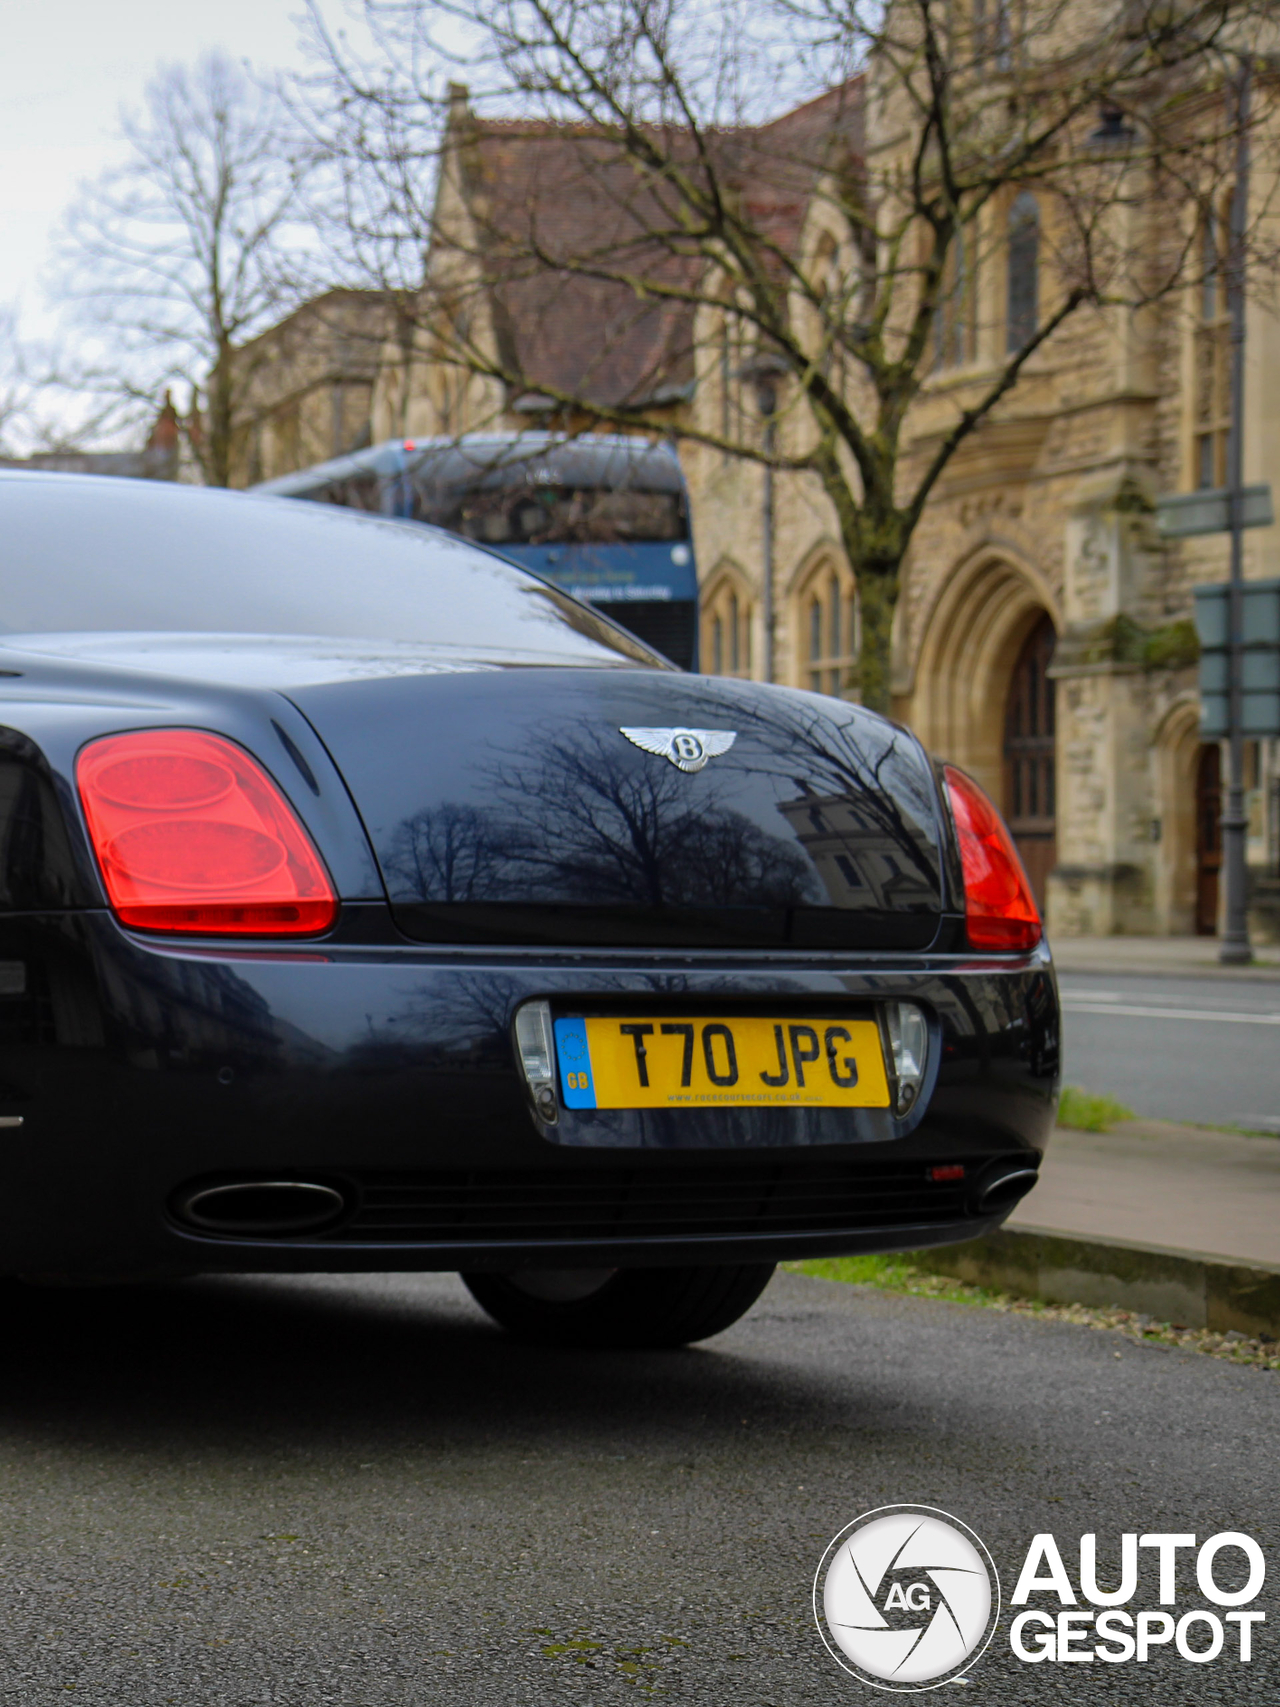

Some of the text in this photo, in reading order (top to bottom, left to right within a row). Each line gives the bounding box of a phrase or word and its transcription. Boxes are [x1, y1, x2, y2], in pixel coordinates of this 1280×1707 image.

[620, 1024, 858, 1088] T70 JPG
[568, 1072, 588, 1089] GB
[668, 1093, 801, 1102] www.racecoursecars.co.uk
